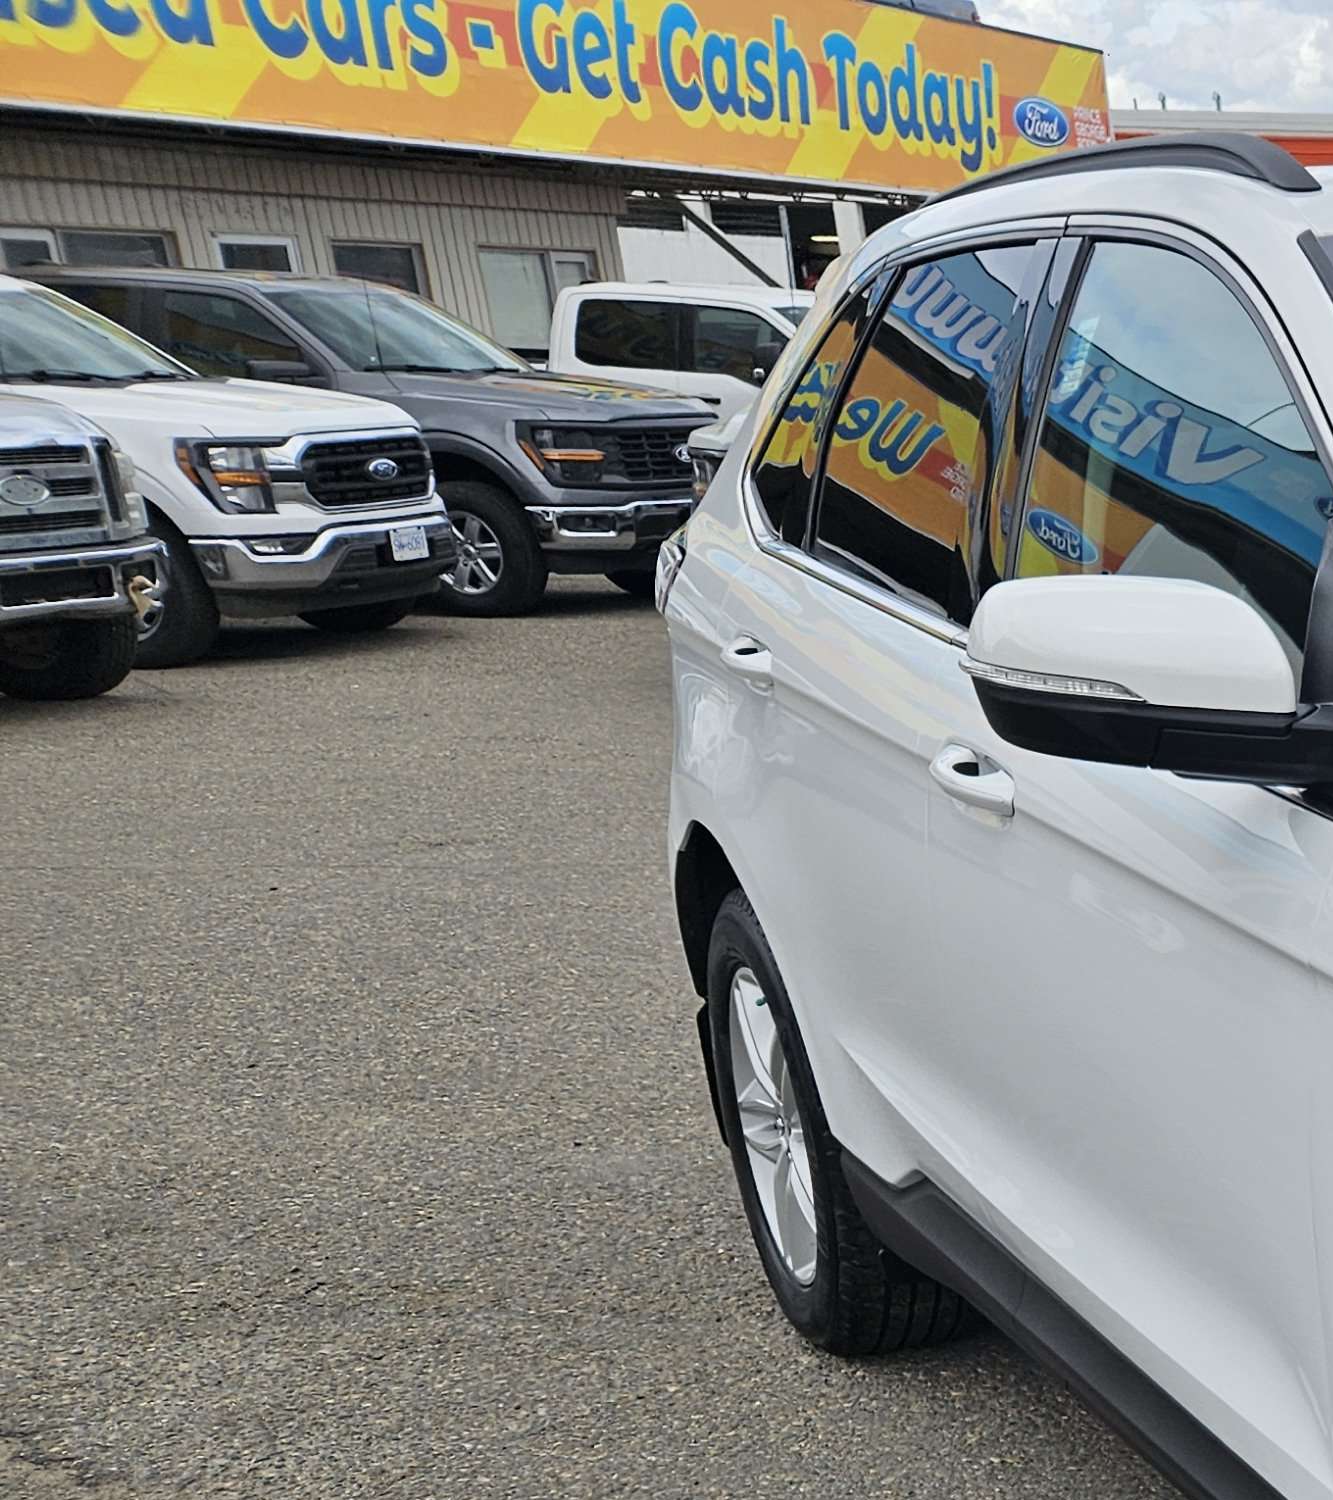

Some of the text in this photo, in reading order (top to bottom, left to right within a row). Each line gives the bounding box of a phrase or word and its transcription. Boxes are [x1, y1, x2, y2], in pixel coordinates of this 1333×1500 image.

[518, 0, 642, 103] Get
[657, 3, 810, 125] Cash
[823, 31, 997, 172] Today!
[1024, 103, 1060, 140] Ford
